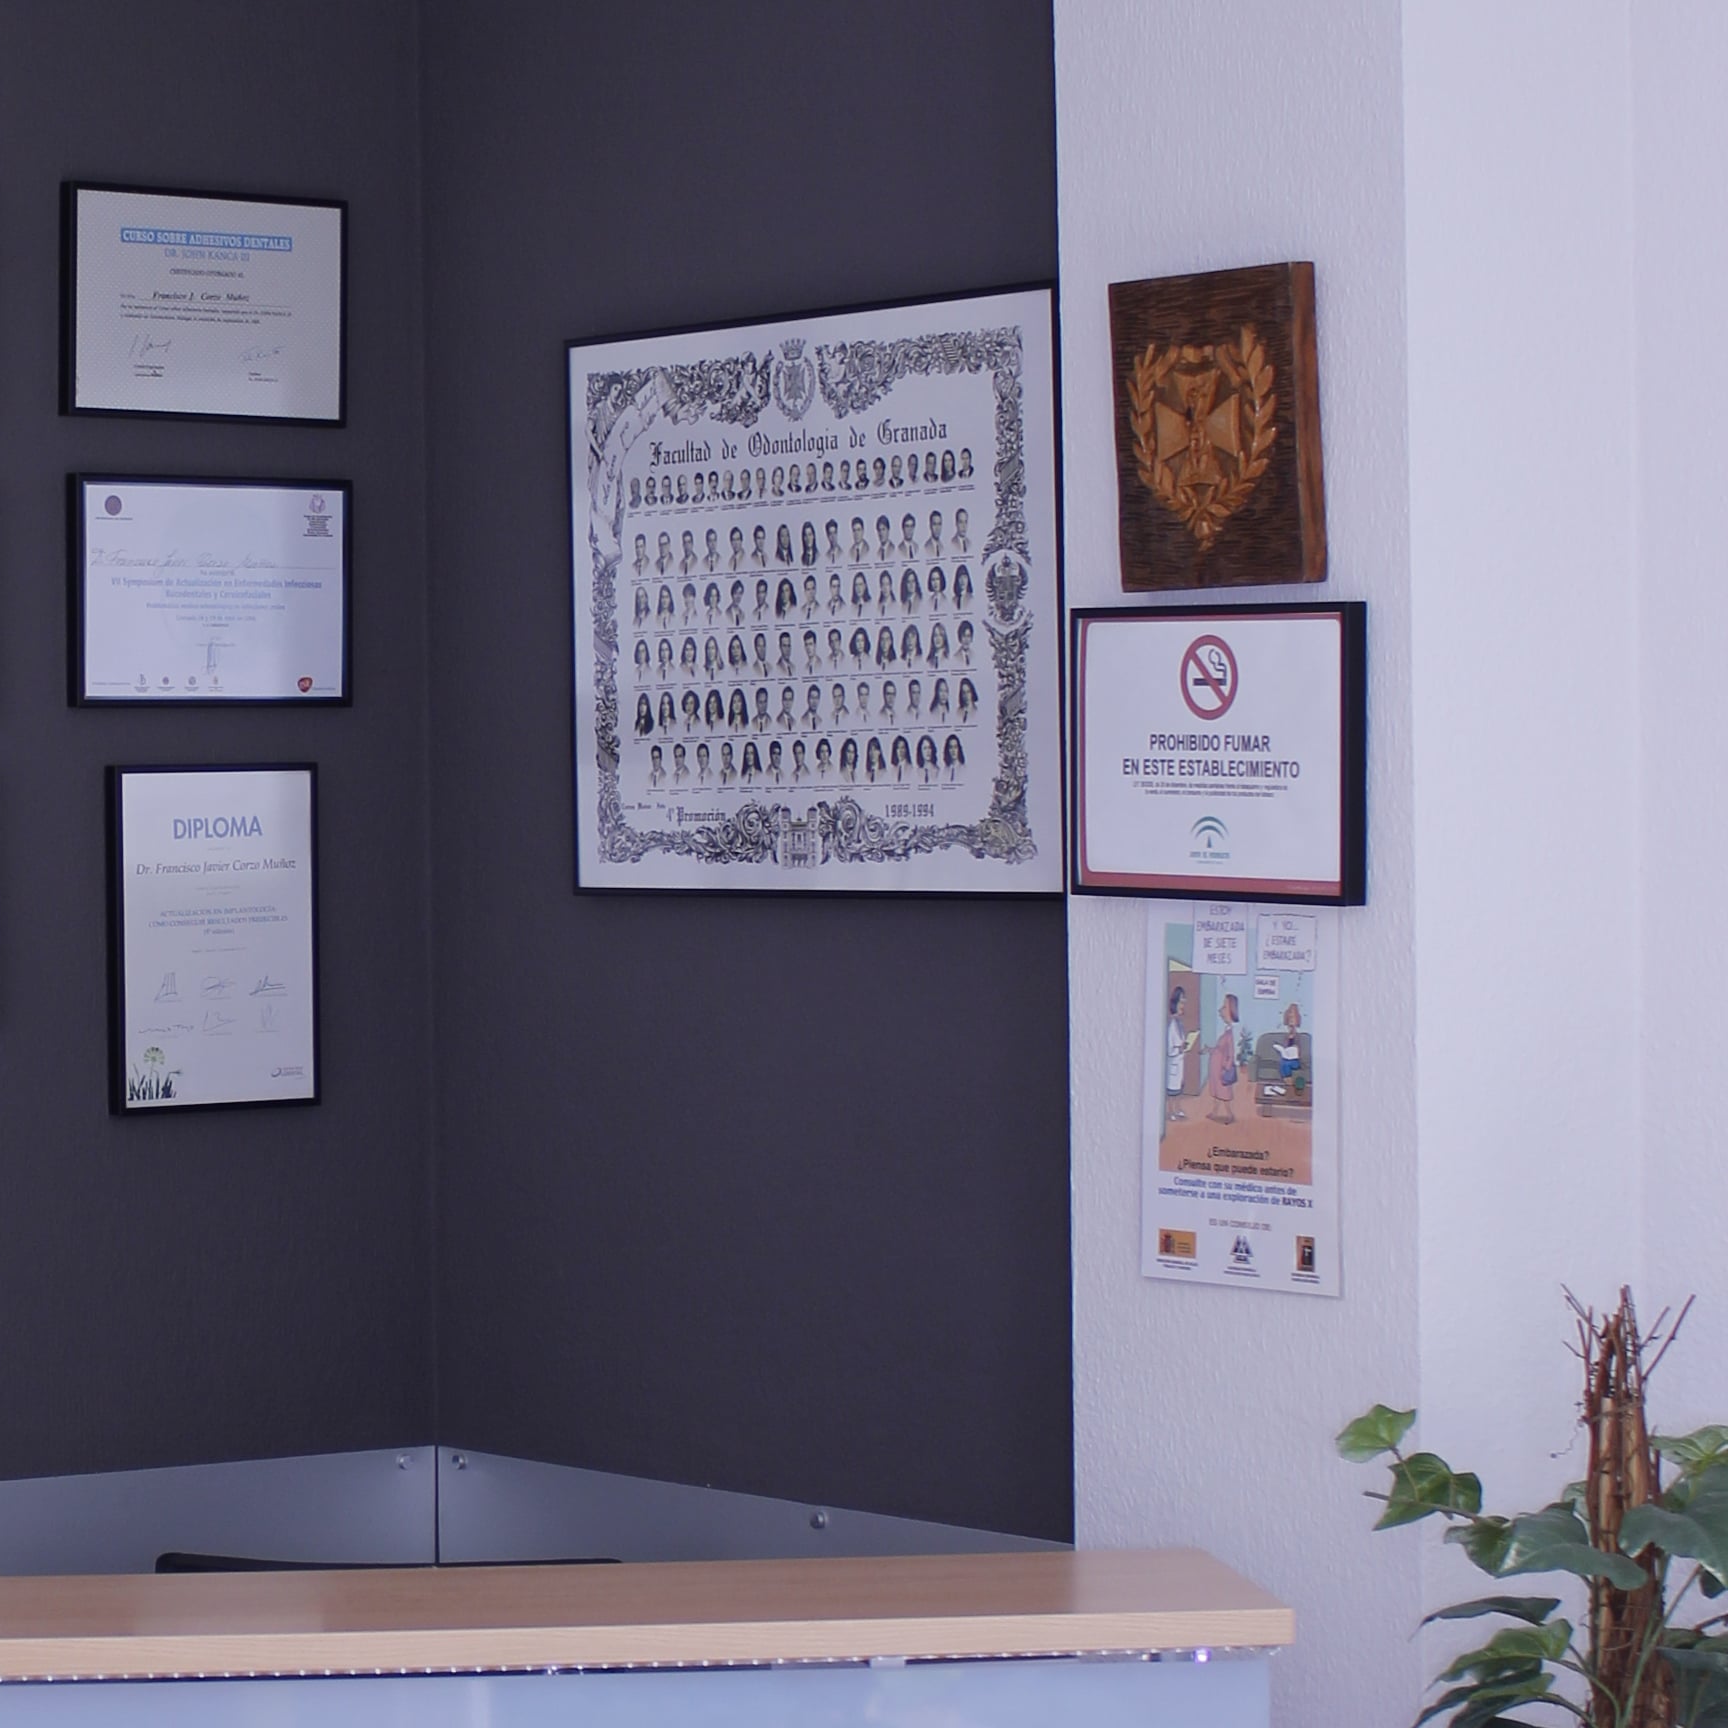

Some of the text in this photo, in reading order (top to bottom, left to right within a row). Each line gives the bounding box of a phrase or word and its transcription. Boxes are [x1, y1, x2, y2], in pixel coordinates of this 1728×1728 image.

[123, 230, 290, 249] CURSO SOBRE ADHESIVOS DENTALES
[650, 441, 711, 473] Facultad
[721, 438, 737, 459] de
[850, 426, 866, 448] de
[877, 418, 947, 445] Granada
[1150, 734, 1271, 751] PROHIBIDO FUMAR
[1123, 759, 1300, 778] EN ESTE ESTABLECIMIENTO
[173, 816, 263, 839] DIPLOMA
[137, 858, 296, 875] Dr. Francisco Javier Corzo Muñoz
[1207, 1147, 1269, 1160] ¿Embarazada?
[1178, 1159, 1294, 1177] ¿Piensa que puede estarlo?
[1174, 1177, 1206, 1186] Consulte
[1224, 1182, 1232, 1190] su
[1235, 1182, 1263, 1192] médico
[1265, 1186, 1285, 1194] antes
[1287, 1187, 1296, 1195] de
[1159, 1187, 1198, 1198] someterse
[1224, 1192, 1268, 1203] exploración
[1271, 1196, 1280, 1205] de
[1282, 1197, 1306, 1207] RAYOS
[1307, 1200, 1312, 1208] X
